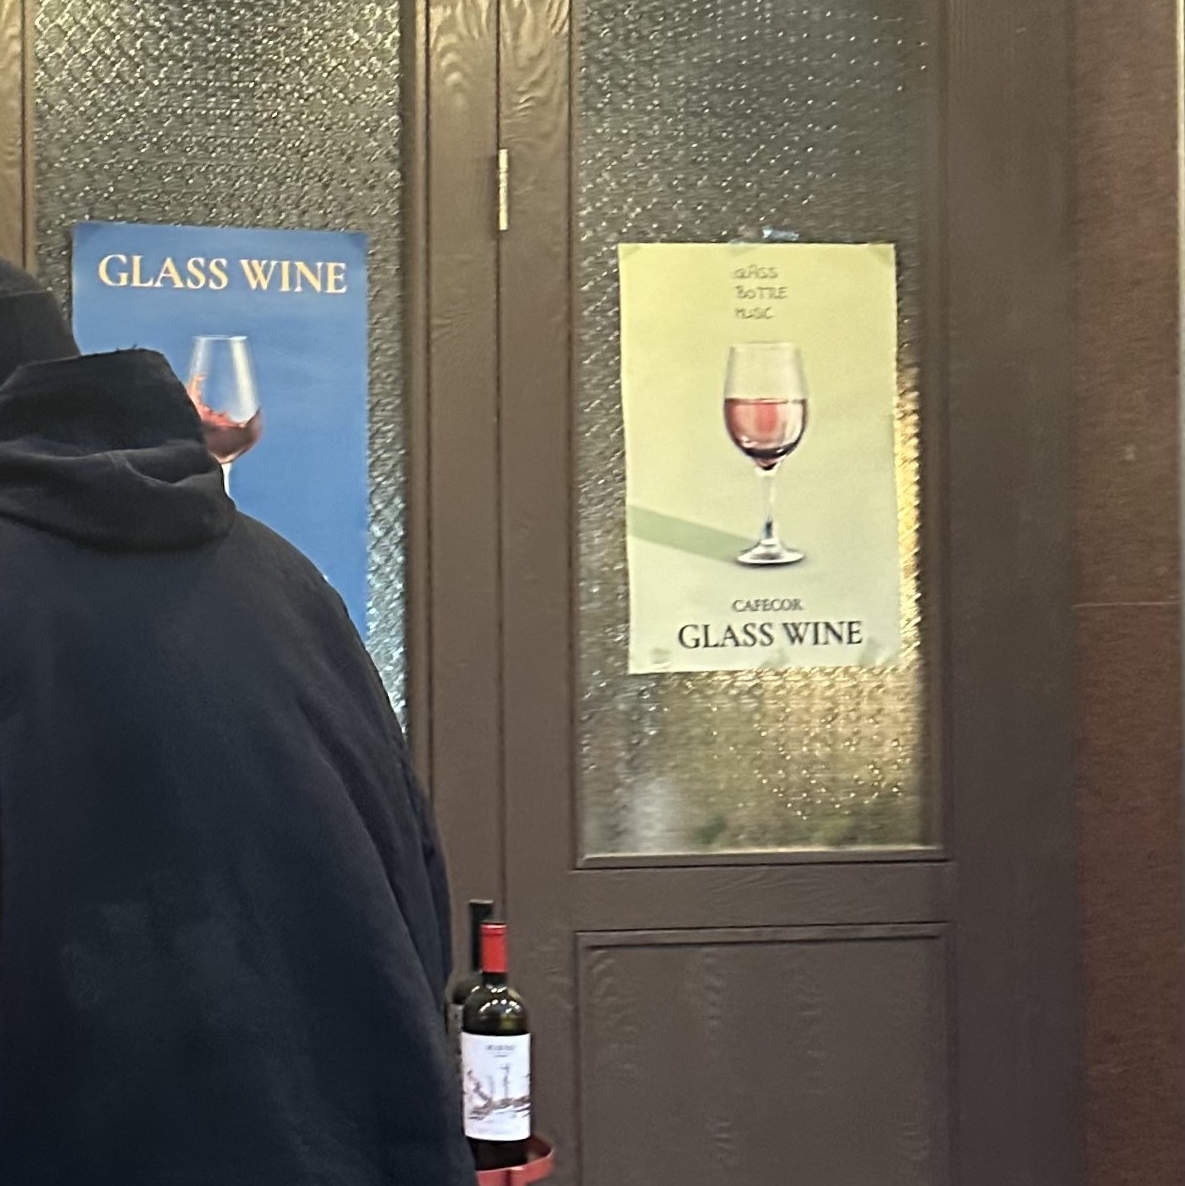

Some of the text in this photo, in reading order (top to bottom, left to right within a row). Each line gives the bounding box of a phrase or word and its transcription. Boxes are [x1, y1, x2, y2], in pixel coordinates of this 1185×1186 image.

[98, 254, 348, 294] GLASS WINE
[735, 285, 790, 300] BOTTLE
[732, 599, 804, 612] CAFECOR
[678, 620, 863, 649] GLASS WINE
